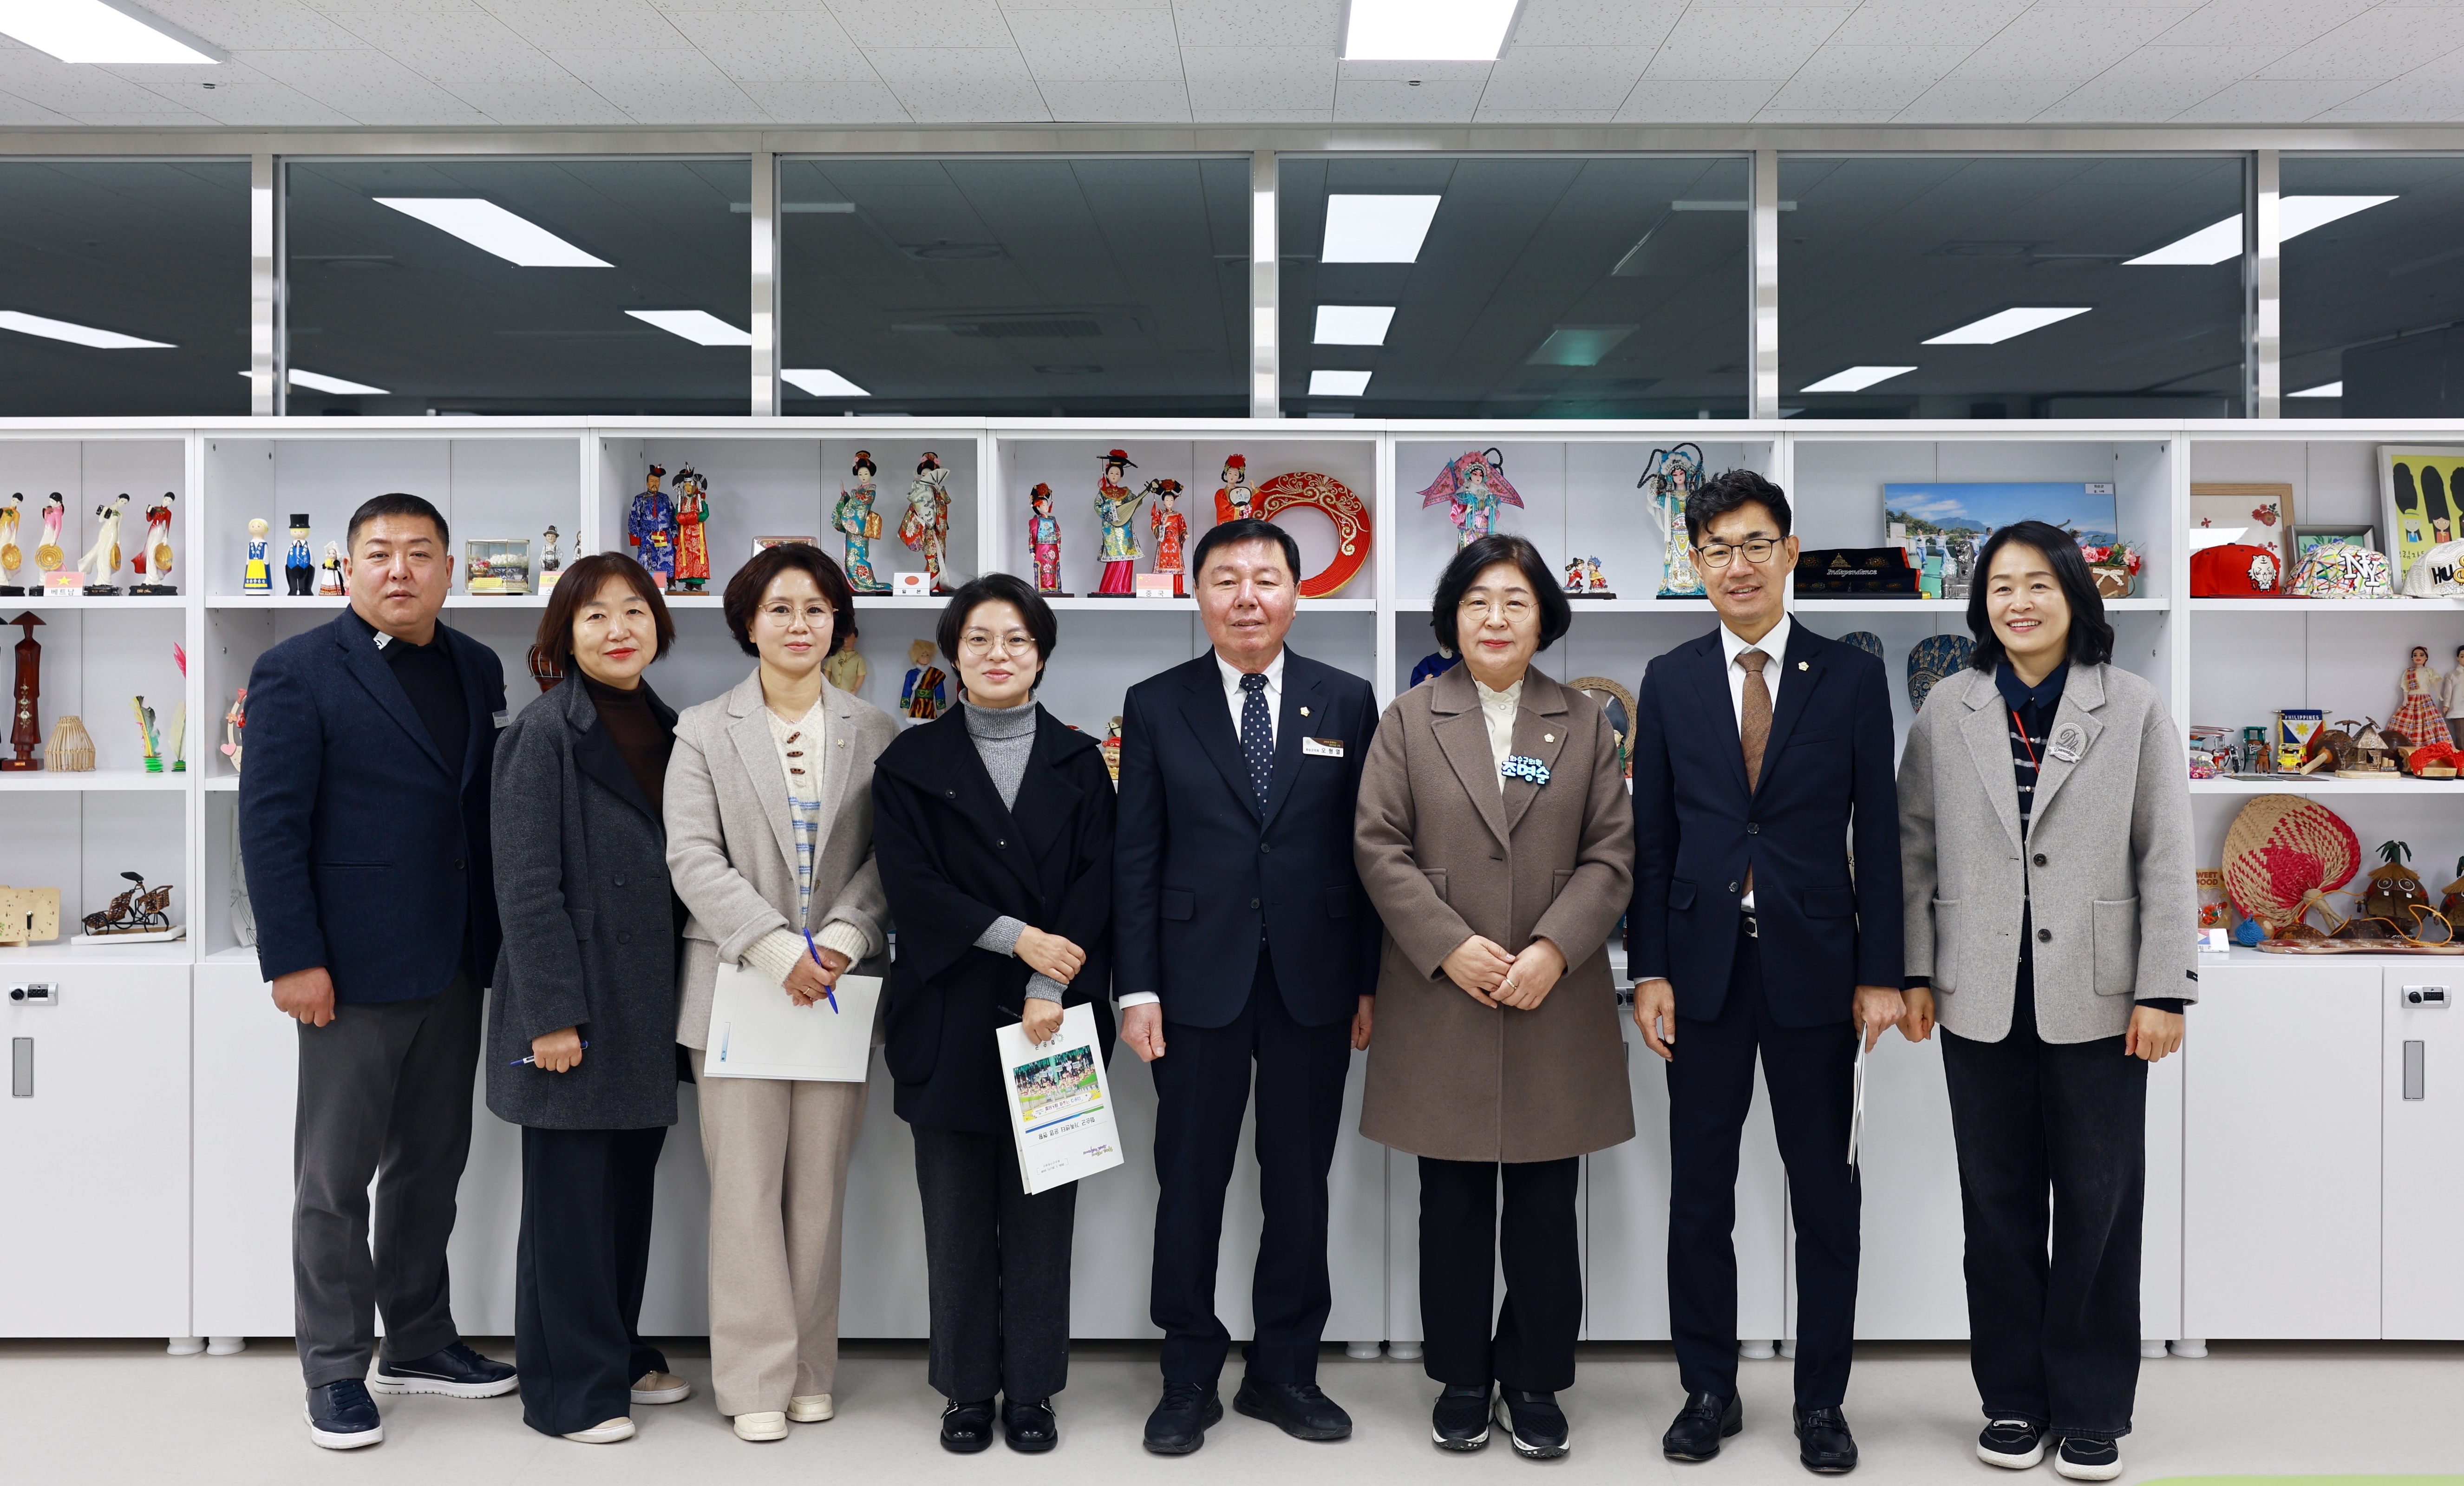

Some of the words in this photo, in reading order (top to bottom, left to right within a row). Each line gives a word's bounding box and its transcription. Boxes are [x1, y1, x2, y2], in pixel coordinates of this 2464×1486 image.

[1827, 569, 1877, 577] Independence
[2340, 552, 2380, 587] NY
[1509, 755, 1542, 767] 화순군의원
[1502, 761, 1550, 785] 조명순
[1081, 1117, 1095, 1126] 화순군
[1061, 1122, 1079, 1133] 가족센터
